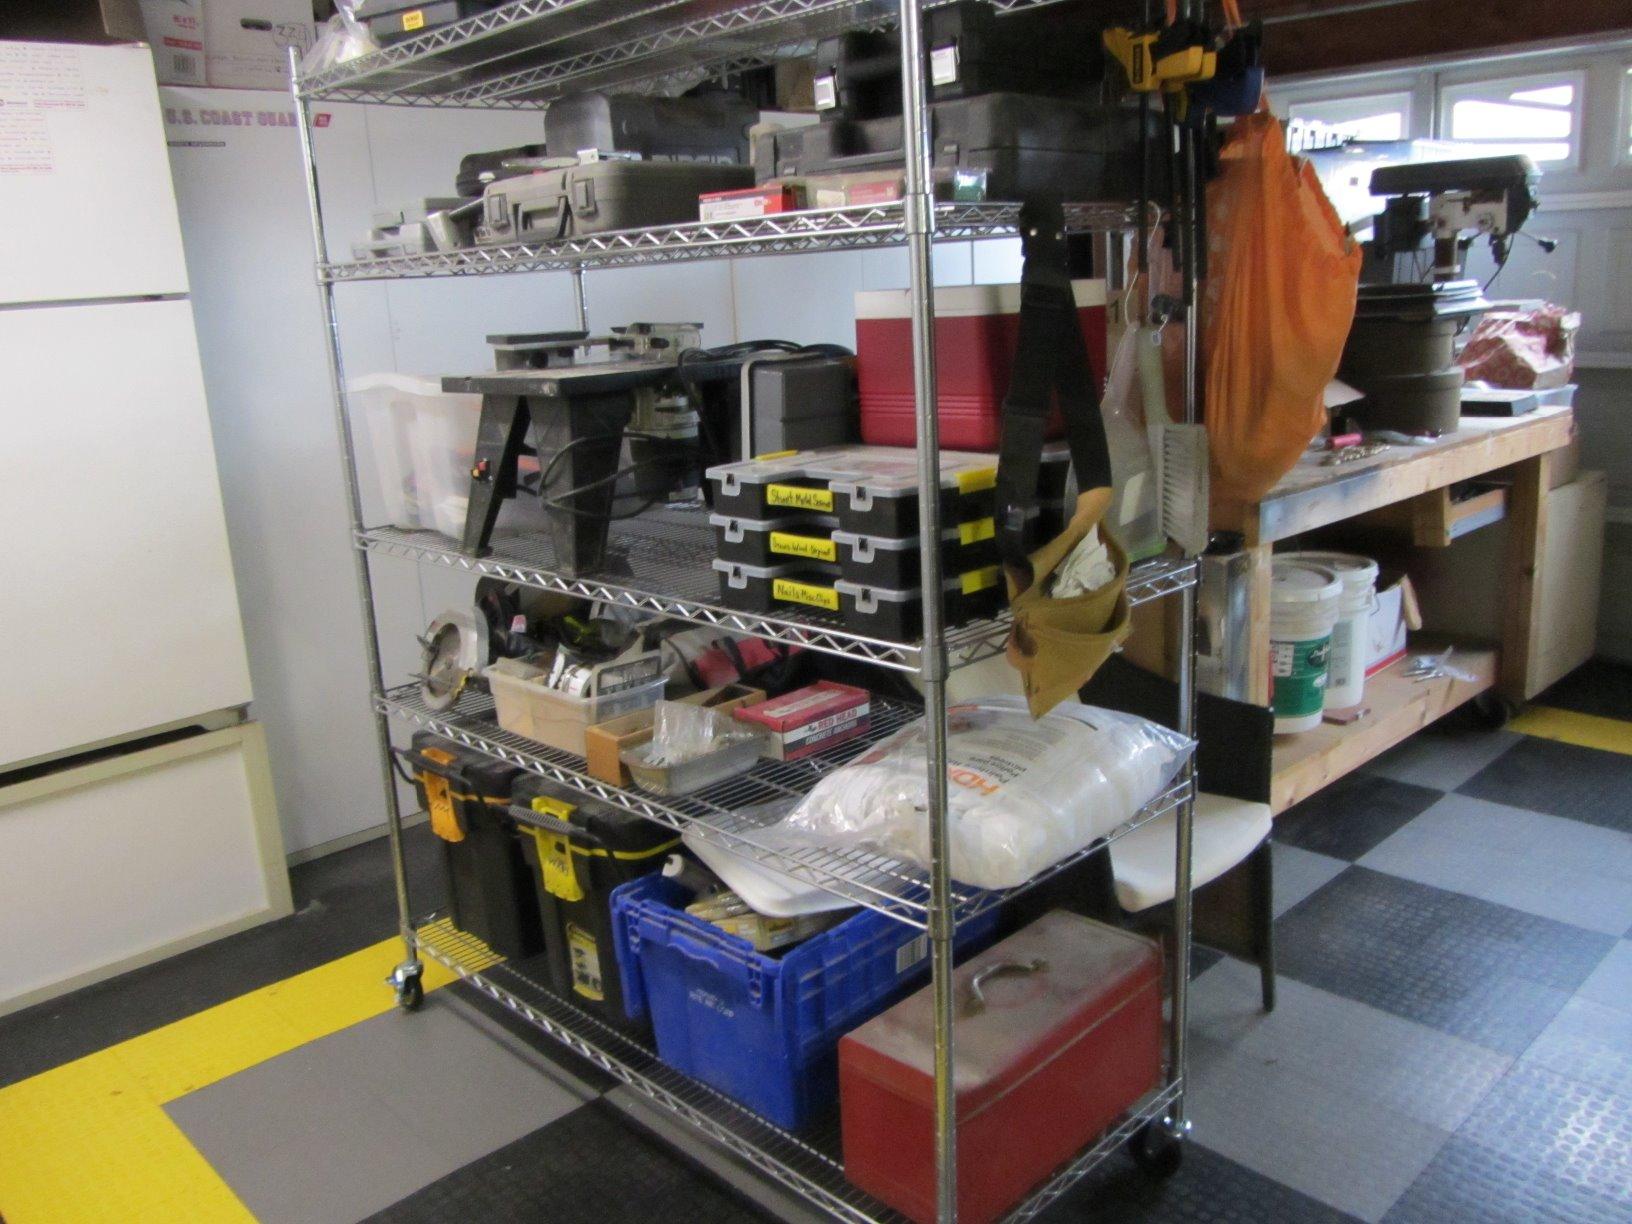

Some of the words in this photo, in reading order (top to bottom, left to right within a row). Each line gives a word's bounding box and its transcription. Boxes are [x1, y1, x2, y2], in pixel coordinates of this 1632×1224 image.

[200, 110, 253, 126] COAST
[257, 111, 298, 127] GUAR
[817, 717, 835, 729] RED
[837, 708, 858, 722] HEAD
